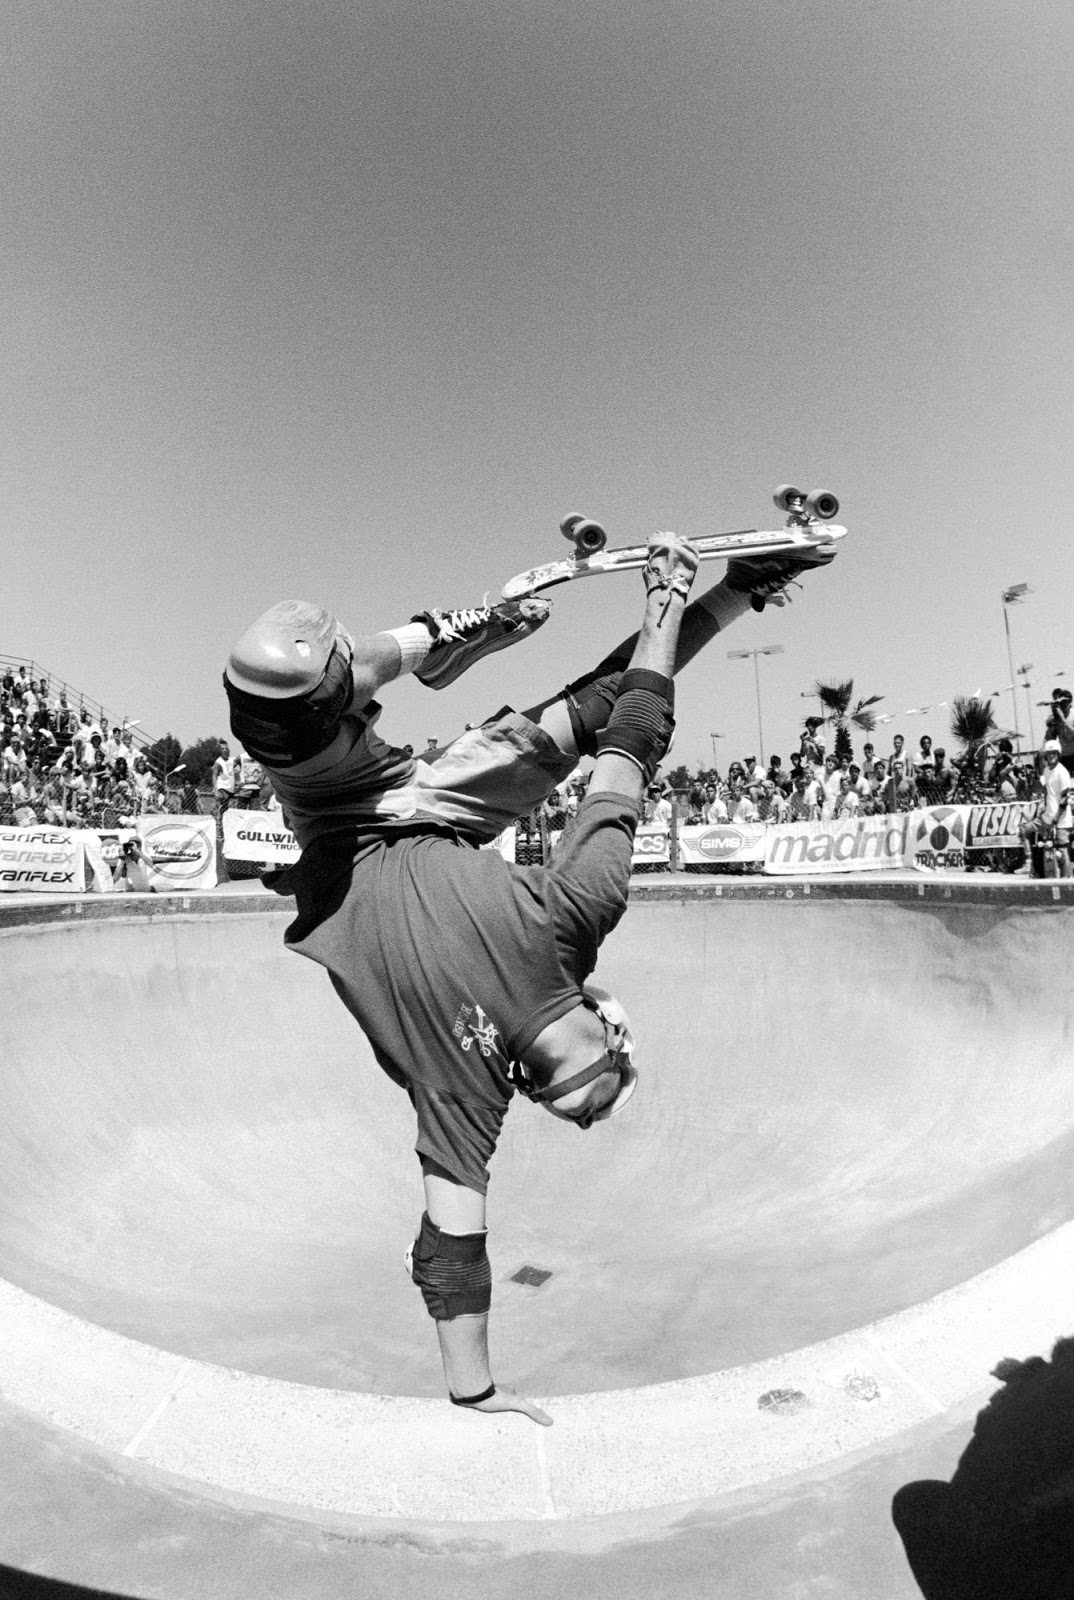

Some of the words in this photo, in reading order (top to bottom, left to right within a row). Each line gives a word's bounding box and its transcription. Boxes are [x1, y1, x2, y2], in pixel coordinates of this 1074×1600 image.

[272, 843, 301, 851] TRUC
[700, 837, 741, 849] SIMS
[769, 816, 910, 863] madrid
[914, 851, 963, 870] TRACKER
